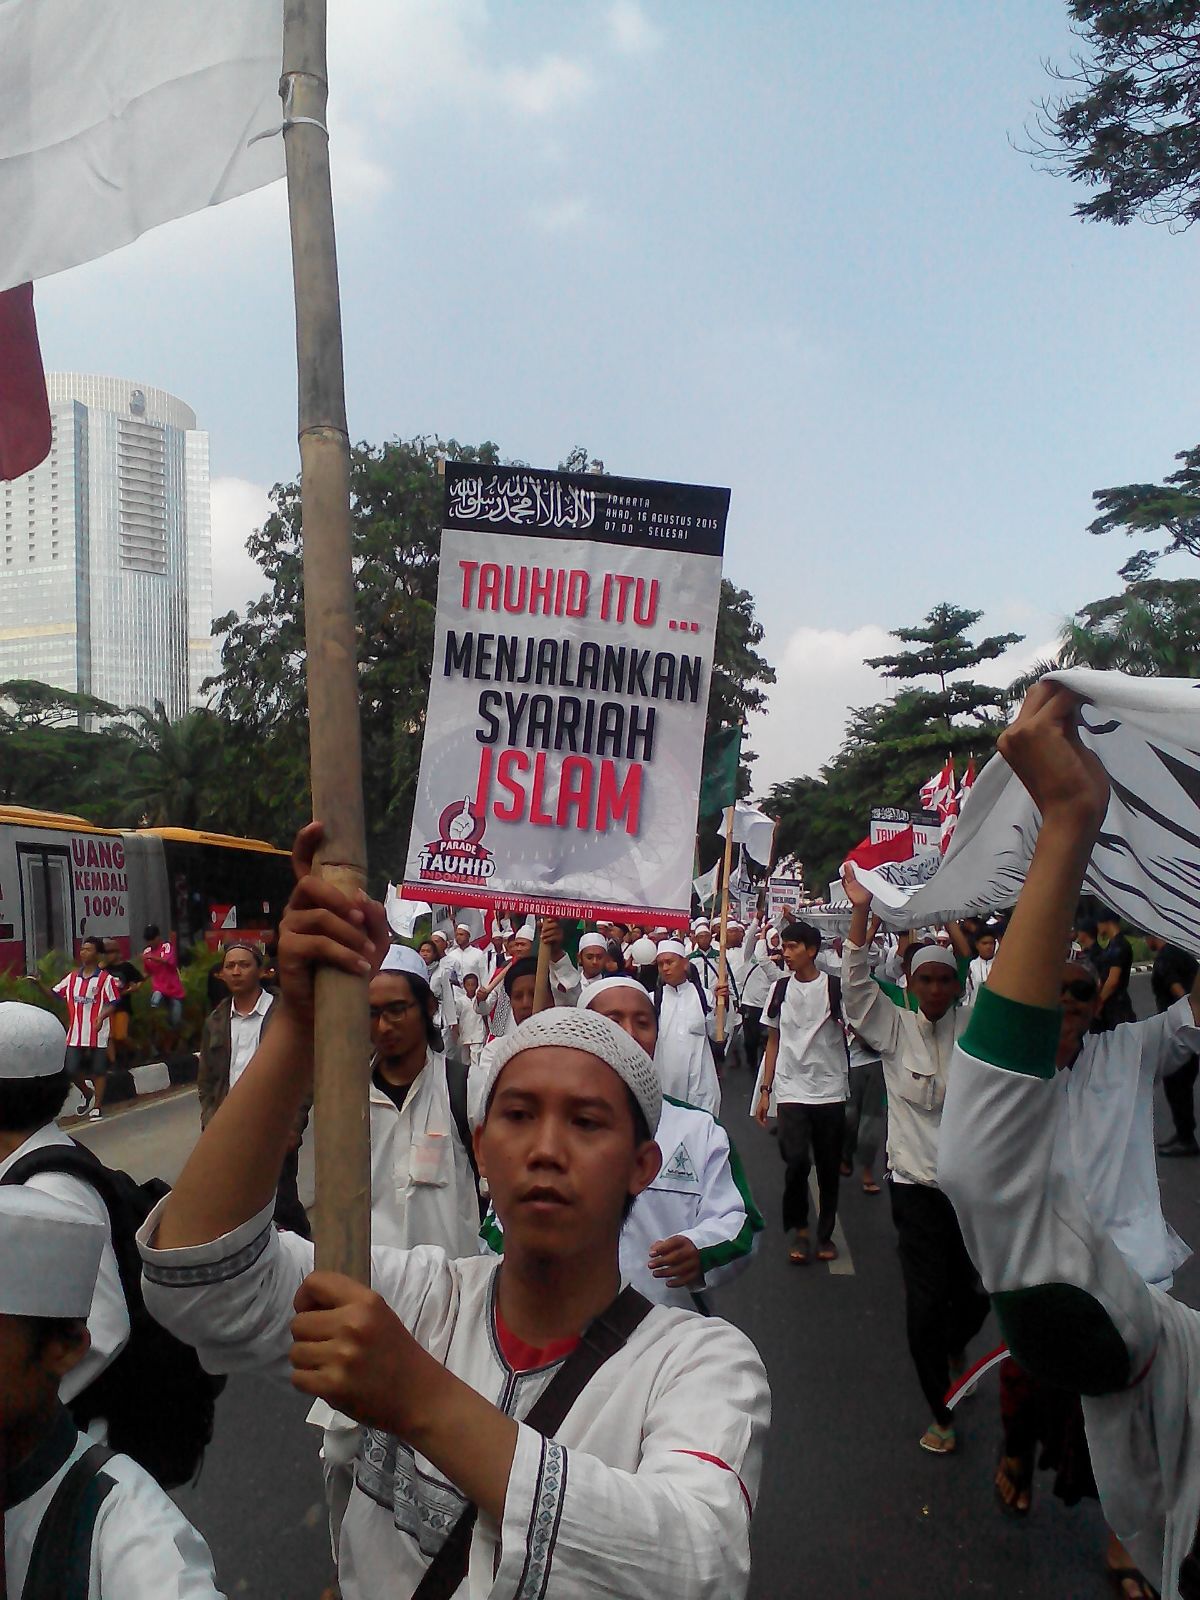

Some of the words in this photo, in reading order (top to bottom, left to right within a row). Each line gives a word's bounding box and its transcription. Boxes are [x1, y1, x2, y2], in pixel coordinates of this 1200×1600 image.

[607, 494, 650, 509] JAKARTA
[605, 508, 633, 521] AHAD,
[637, 511, 647, 522] 16
[651, 512, 692, 527] AGUSTUS
[695, 517, 718, 530] 2015
[648, 526, 688, 540] SELESAI
[458, 560, 590, 617] TAUHID
[600, 573, 659, 627] ITU
[443, 630, 702, 703] MENJALANKAN
[475, 690, 656, 761] SYARIAH
[474, 746, 643, 835] ISLAM
[71, 838, 125, 869] UANG
[440, 841, 477, 855] PARADE
[418, 852, 495, 878] TAUHID
[74, 871, 129, 892] KEMBALI
[421, 870, 487, 886] INDONESIA
[83, 895, 125, 917] 100%
